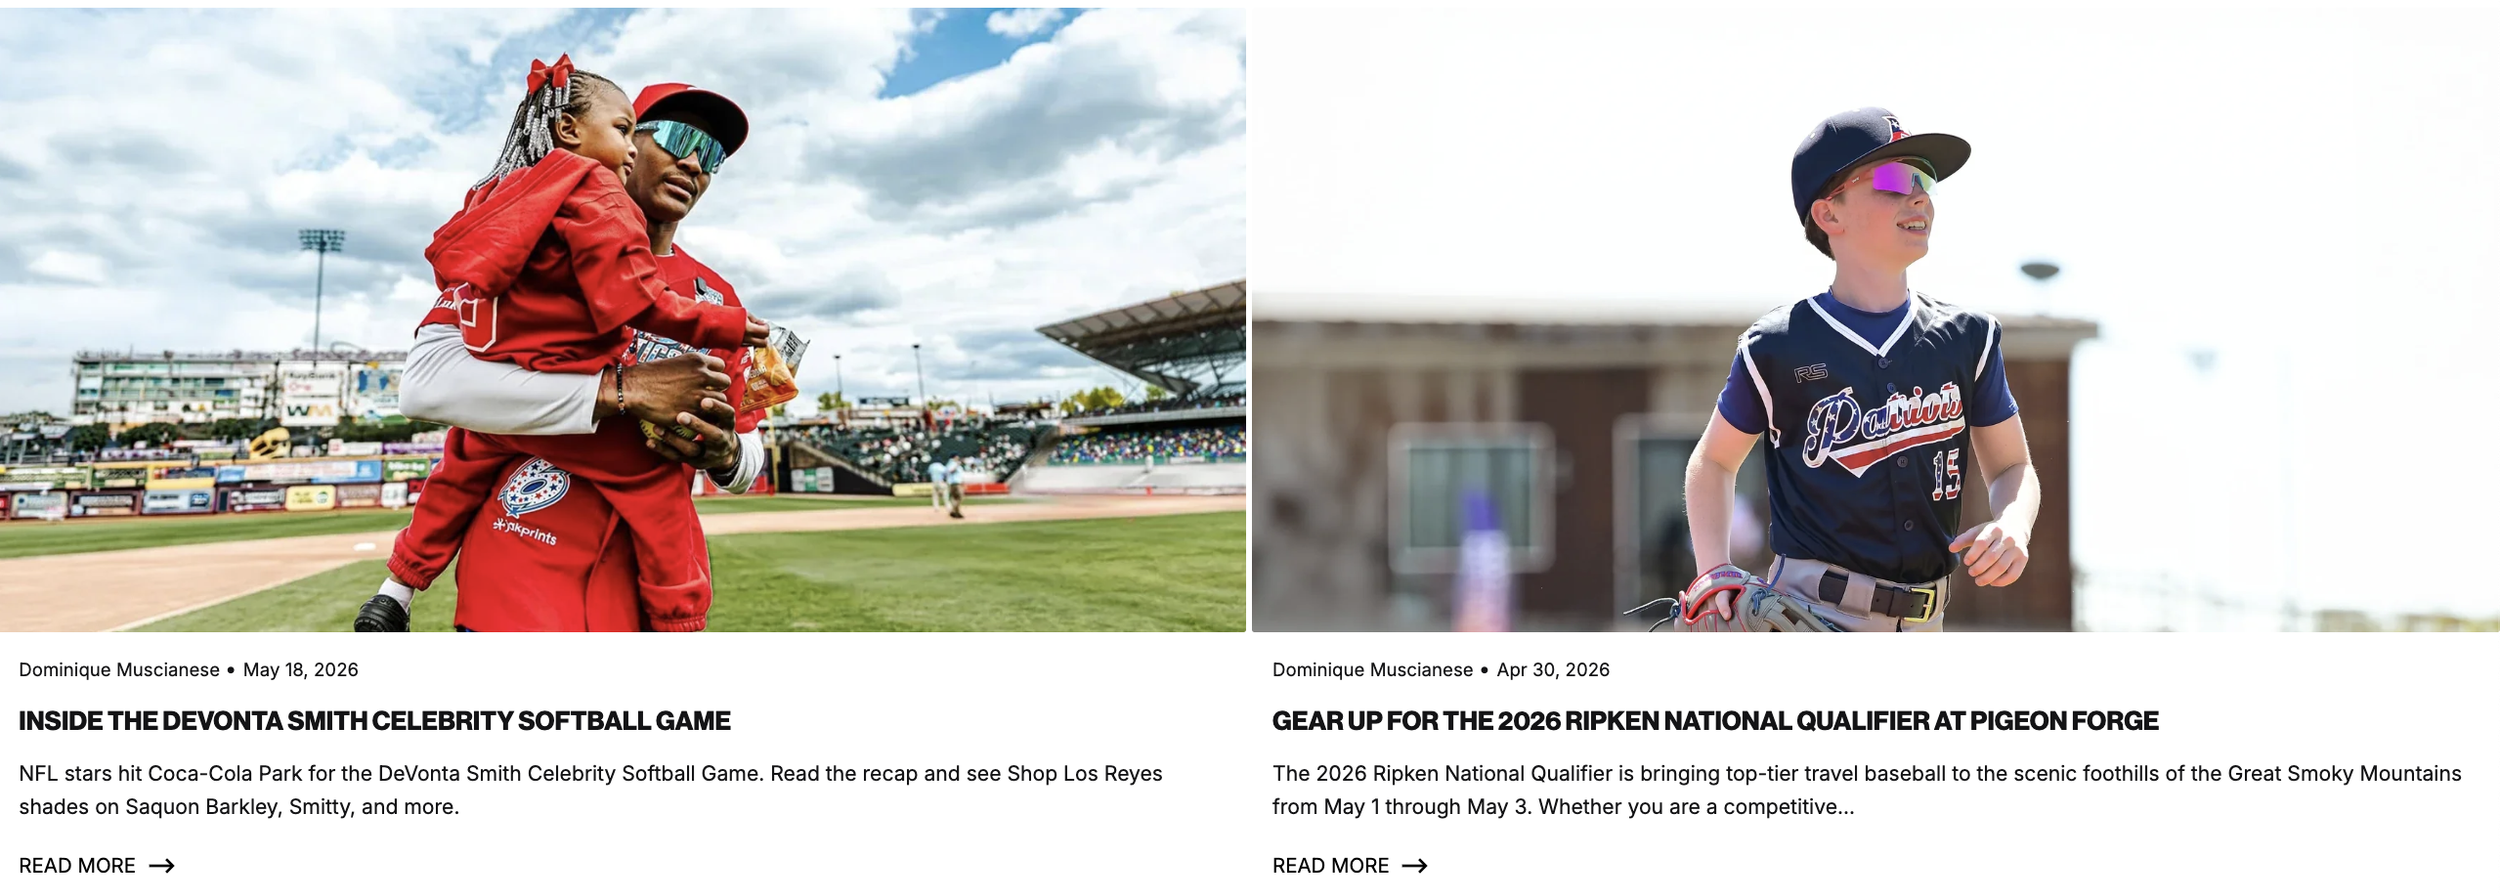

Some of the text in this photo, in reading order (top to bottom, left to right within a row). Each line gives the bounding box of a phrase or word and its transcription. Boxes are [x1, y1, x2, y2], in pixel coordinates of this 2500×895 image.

[1793, 363, 1829, 384] RS
[287, 405, 333, 417] WM
[1802, 381, 1965, 468] Patriots
[1932, 448, 1961, 501] 15
